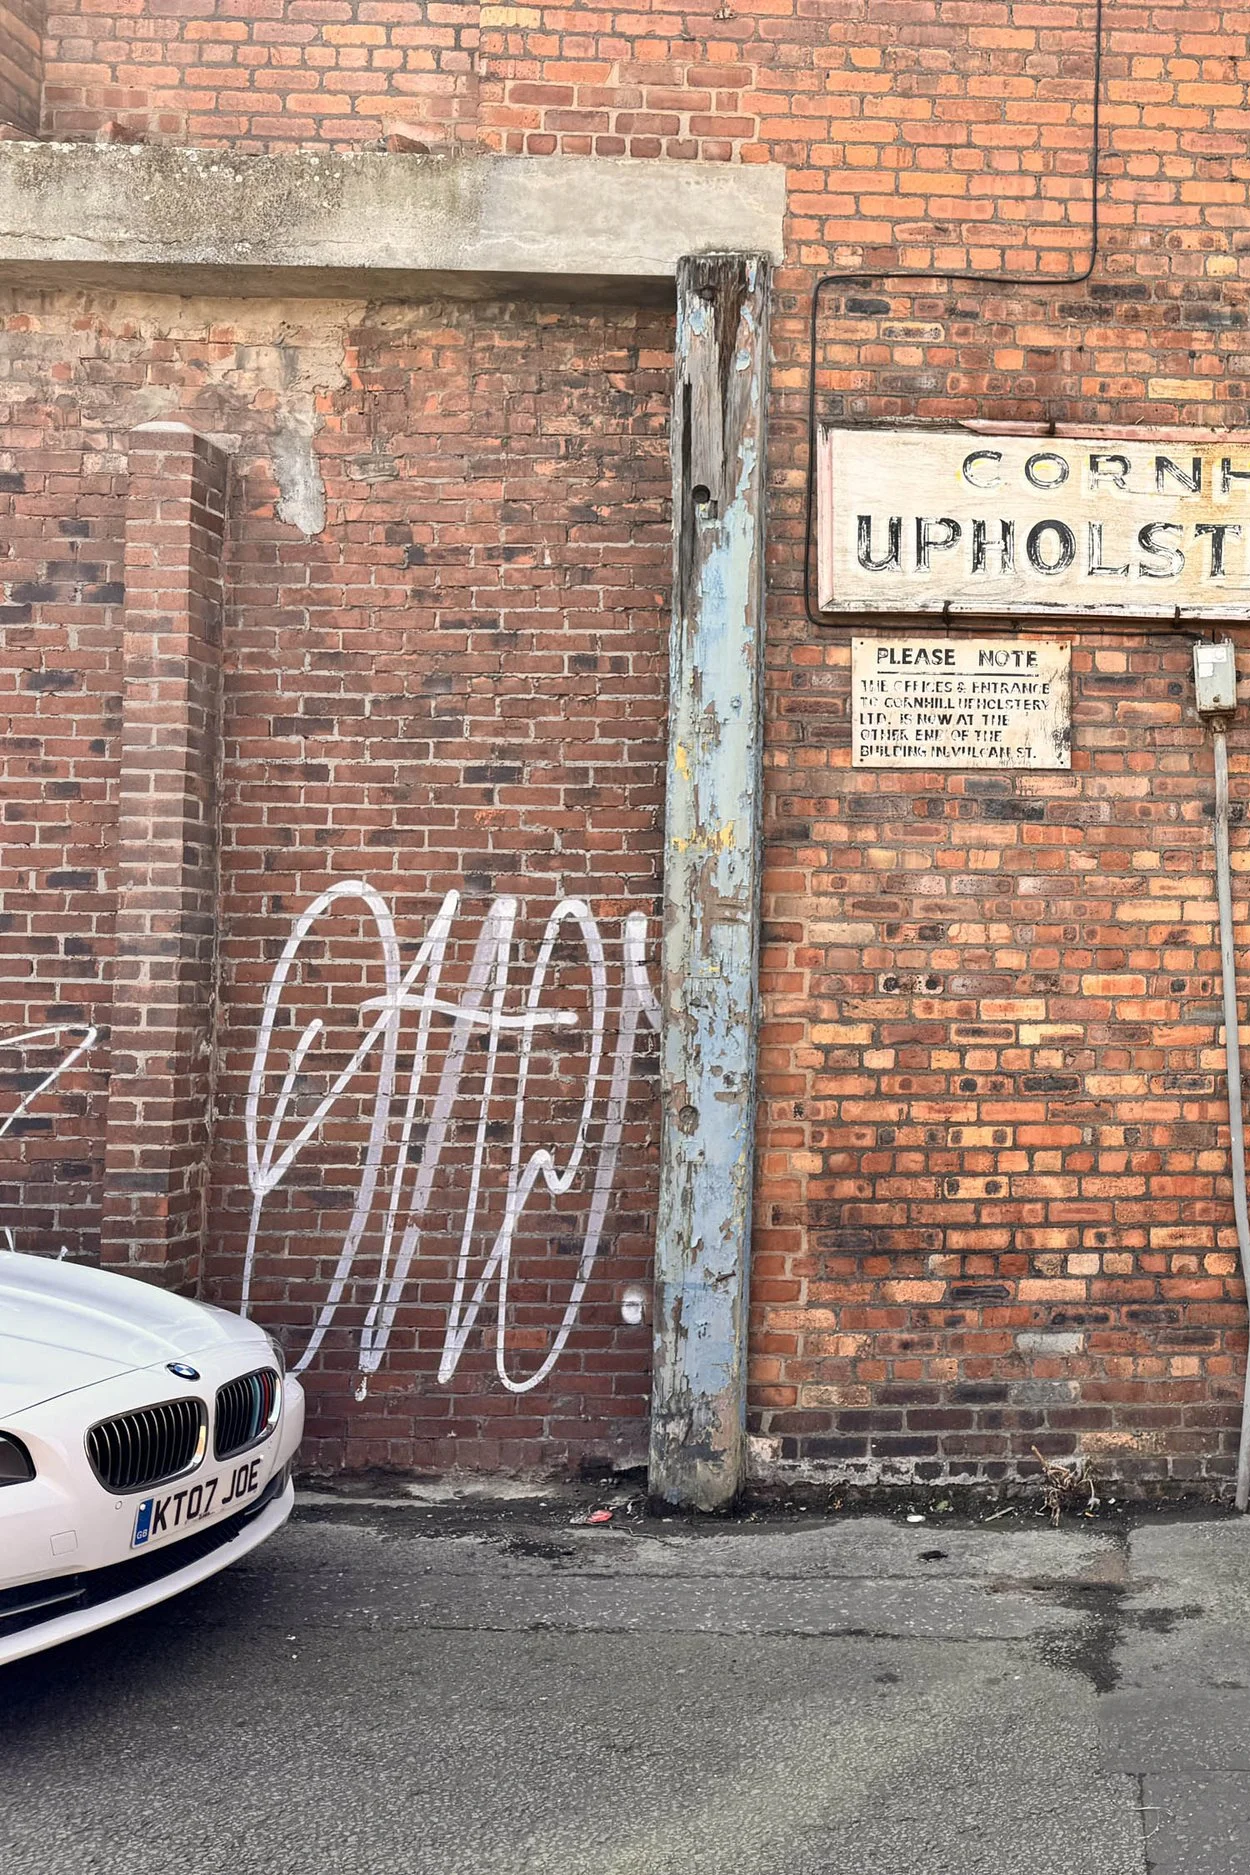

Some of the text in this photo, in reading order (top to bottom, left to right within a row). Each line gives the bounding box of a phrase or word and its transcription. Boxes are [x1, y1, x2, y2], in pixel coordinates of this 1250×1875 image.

[877, 647, 1038, 667] PLEASE NOTE
[972, 681, 1050, 694] ENTRANCE
[884, 697, 955, 709] CORNHILL
[958, 698, 1049, 710] UPHOLSTERY
[899, 713, 912, 725] IS
[917, 713, 953, 725] NOW
[956, 714, 974, 726] AT
[982, 714, 1009, 726] THE
[860, 729, 909, 741] OTHER
[951, 729, 969, 741] OF
[974, 730, 1002, 742] THE
[860, 745, 927, 757] BUILDING
[1016, 746, 1037, 759] ST.
[151, 1458, 261, 1535] KT07 JOE
[136, 1529, 148, 1539] GB
